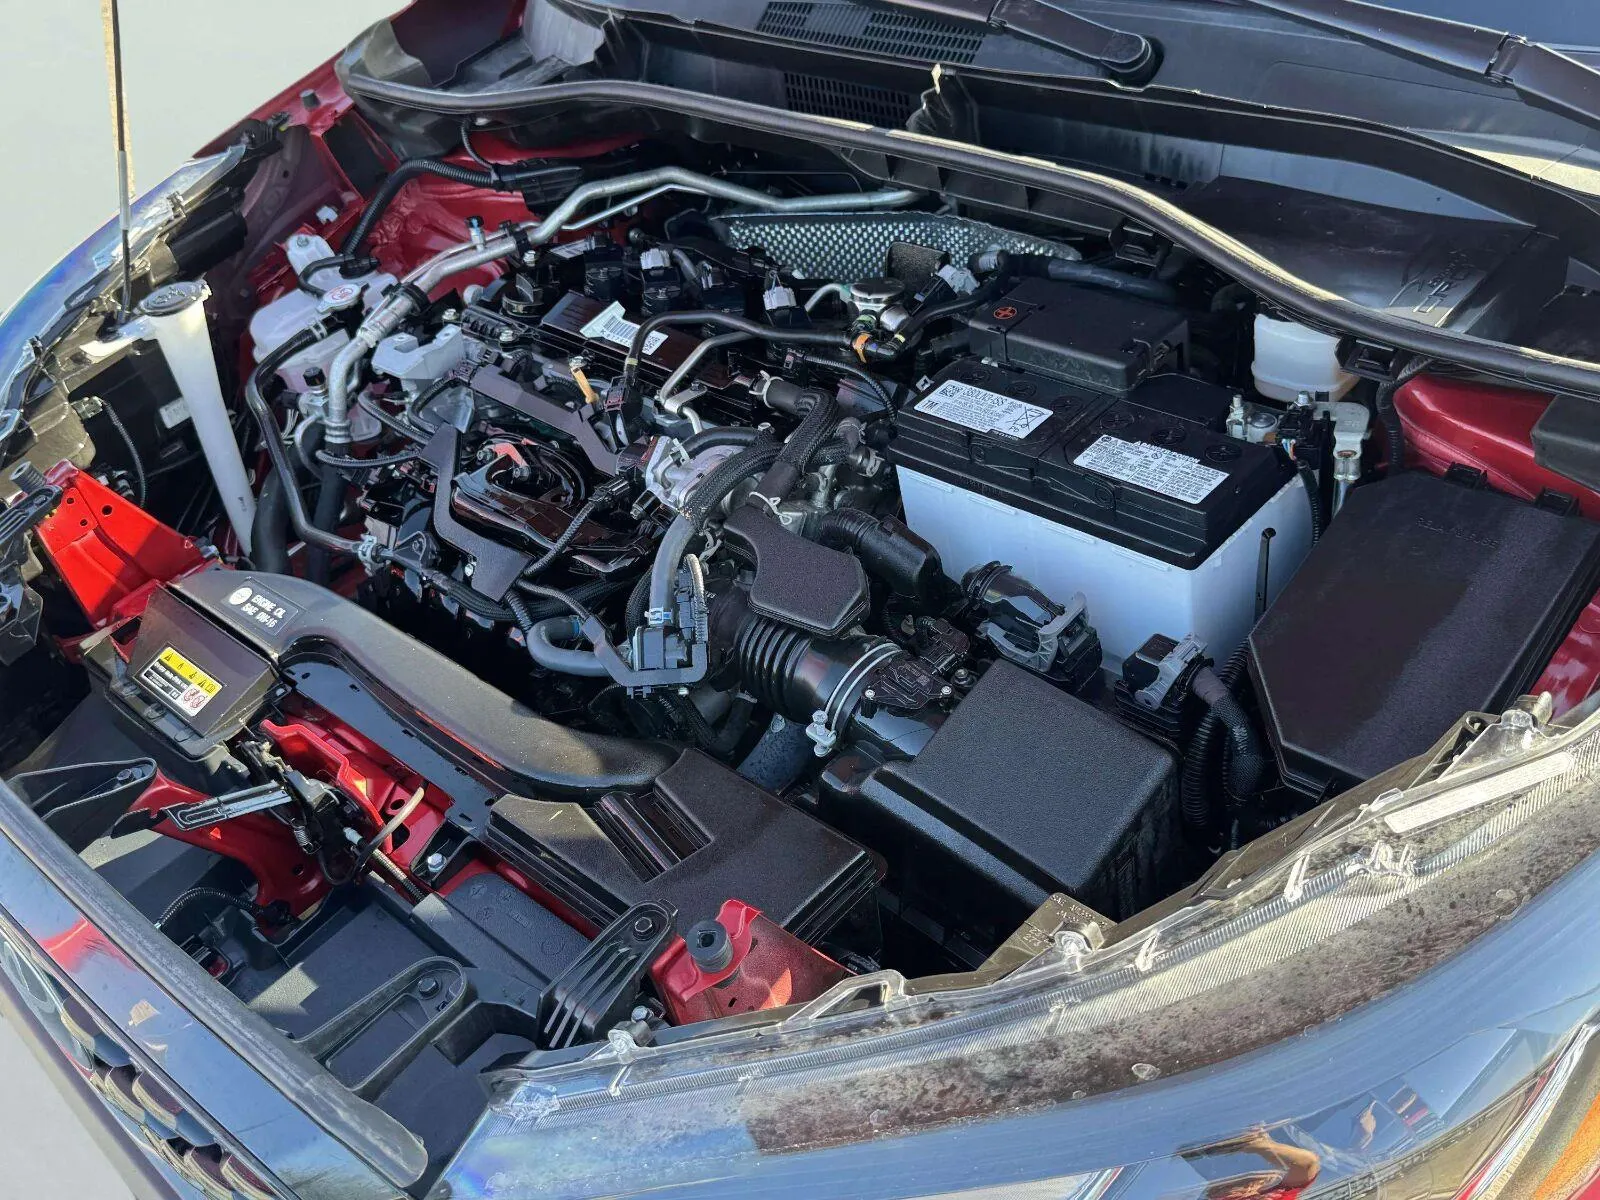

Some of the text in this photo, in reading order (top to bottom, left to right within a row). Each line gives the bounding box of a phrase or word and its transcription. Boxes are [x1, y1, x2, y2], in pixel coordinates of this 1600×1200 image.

[241, 603, 259, 616] SAE
[251, 594, 286, 619] ENGINE OIL
